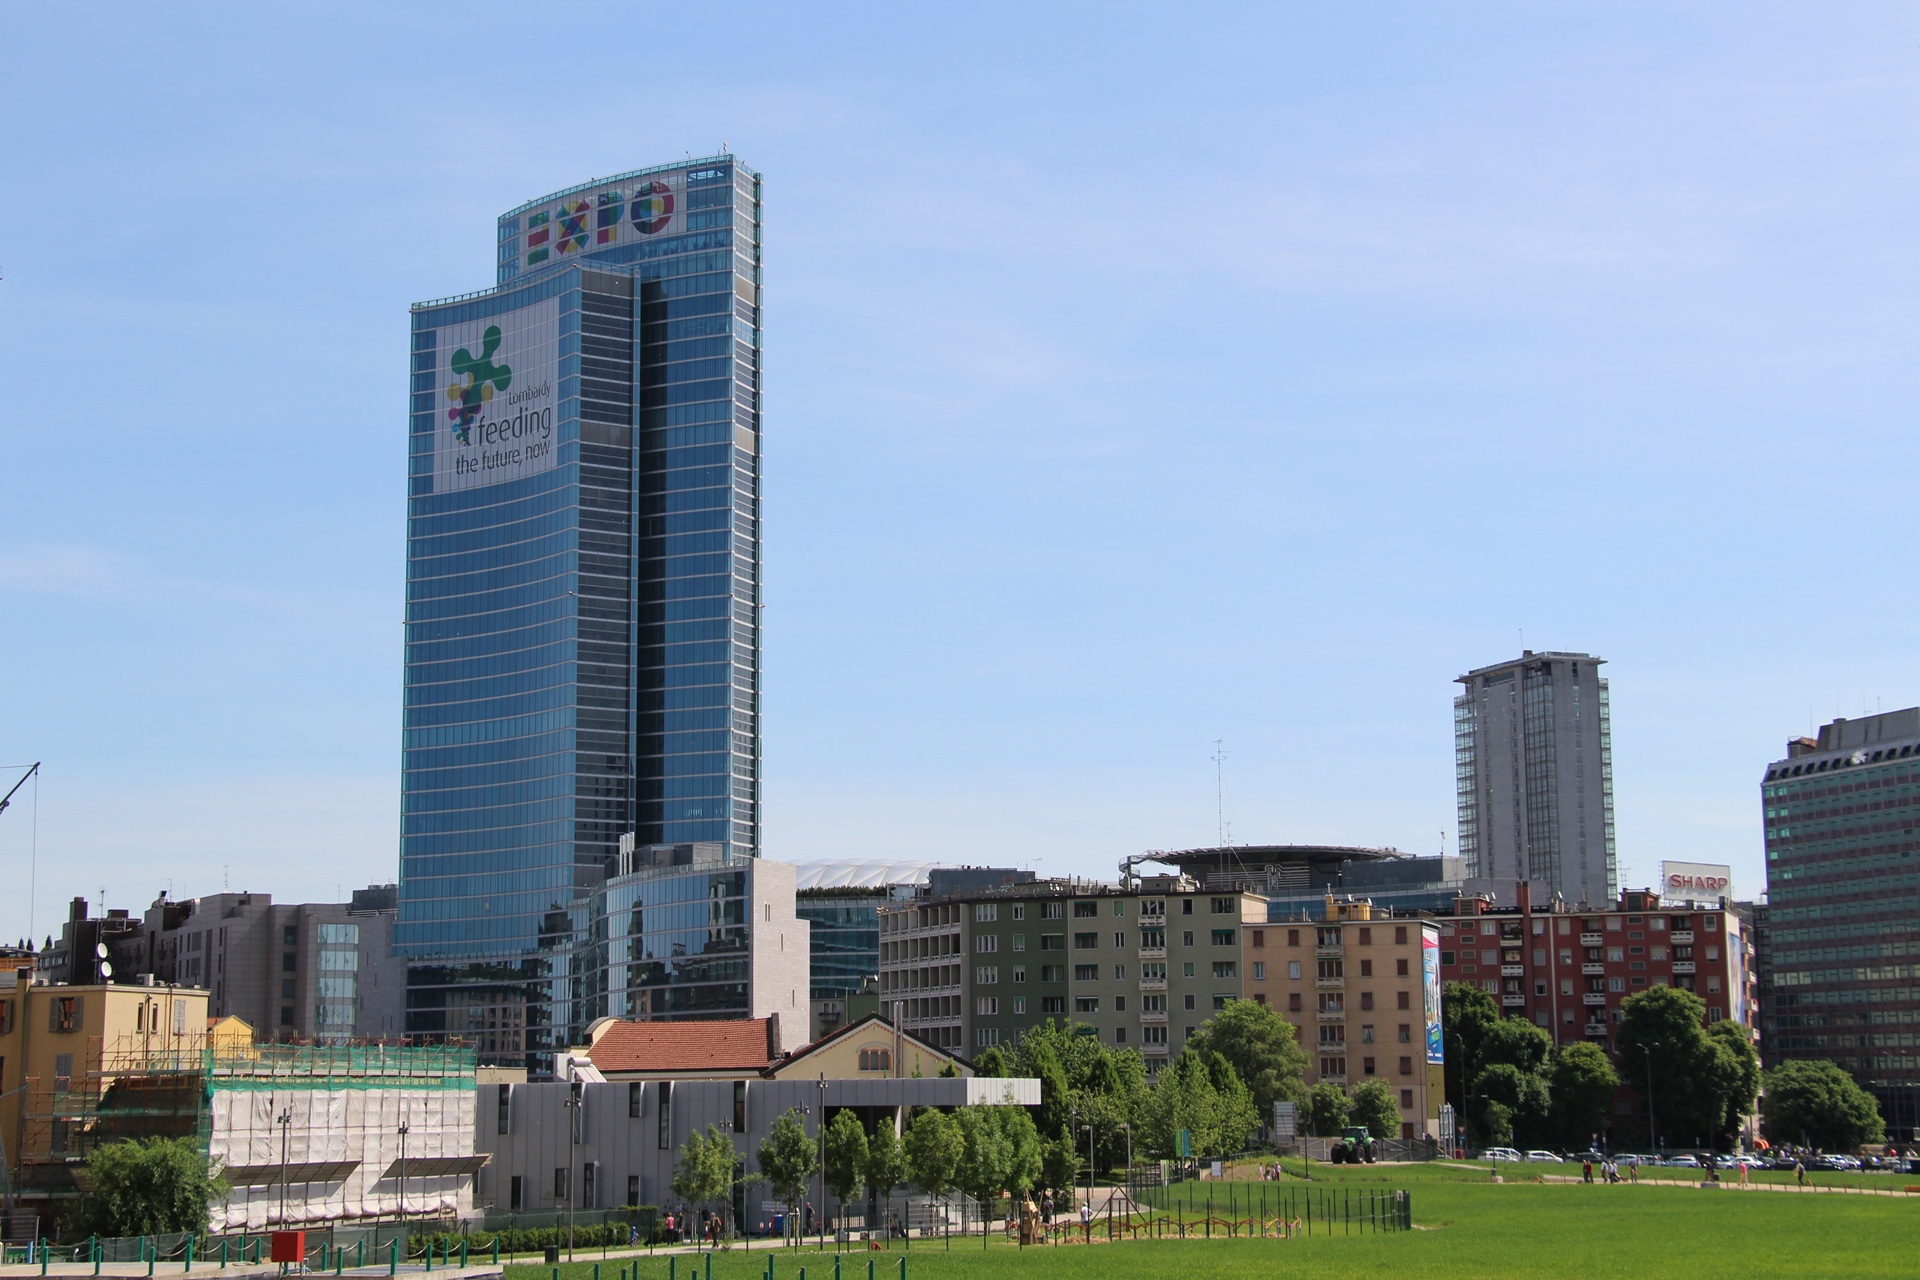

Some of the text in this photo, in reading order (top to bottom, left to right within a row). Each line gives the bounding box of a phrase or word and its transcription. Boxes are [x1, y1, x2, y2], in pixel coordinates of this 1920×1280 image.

[528, 181, 675, 266] EXPO
[509, 380, 551, 406] Lombardy
[478, 406, 551, 446] feeding
[456, 440, 551, 475] the future, now
[1670, 873, 1728, 890] SHARP
